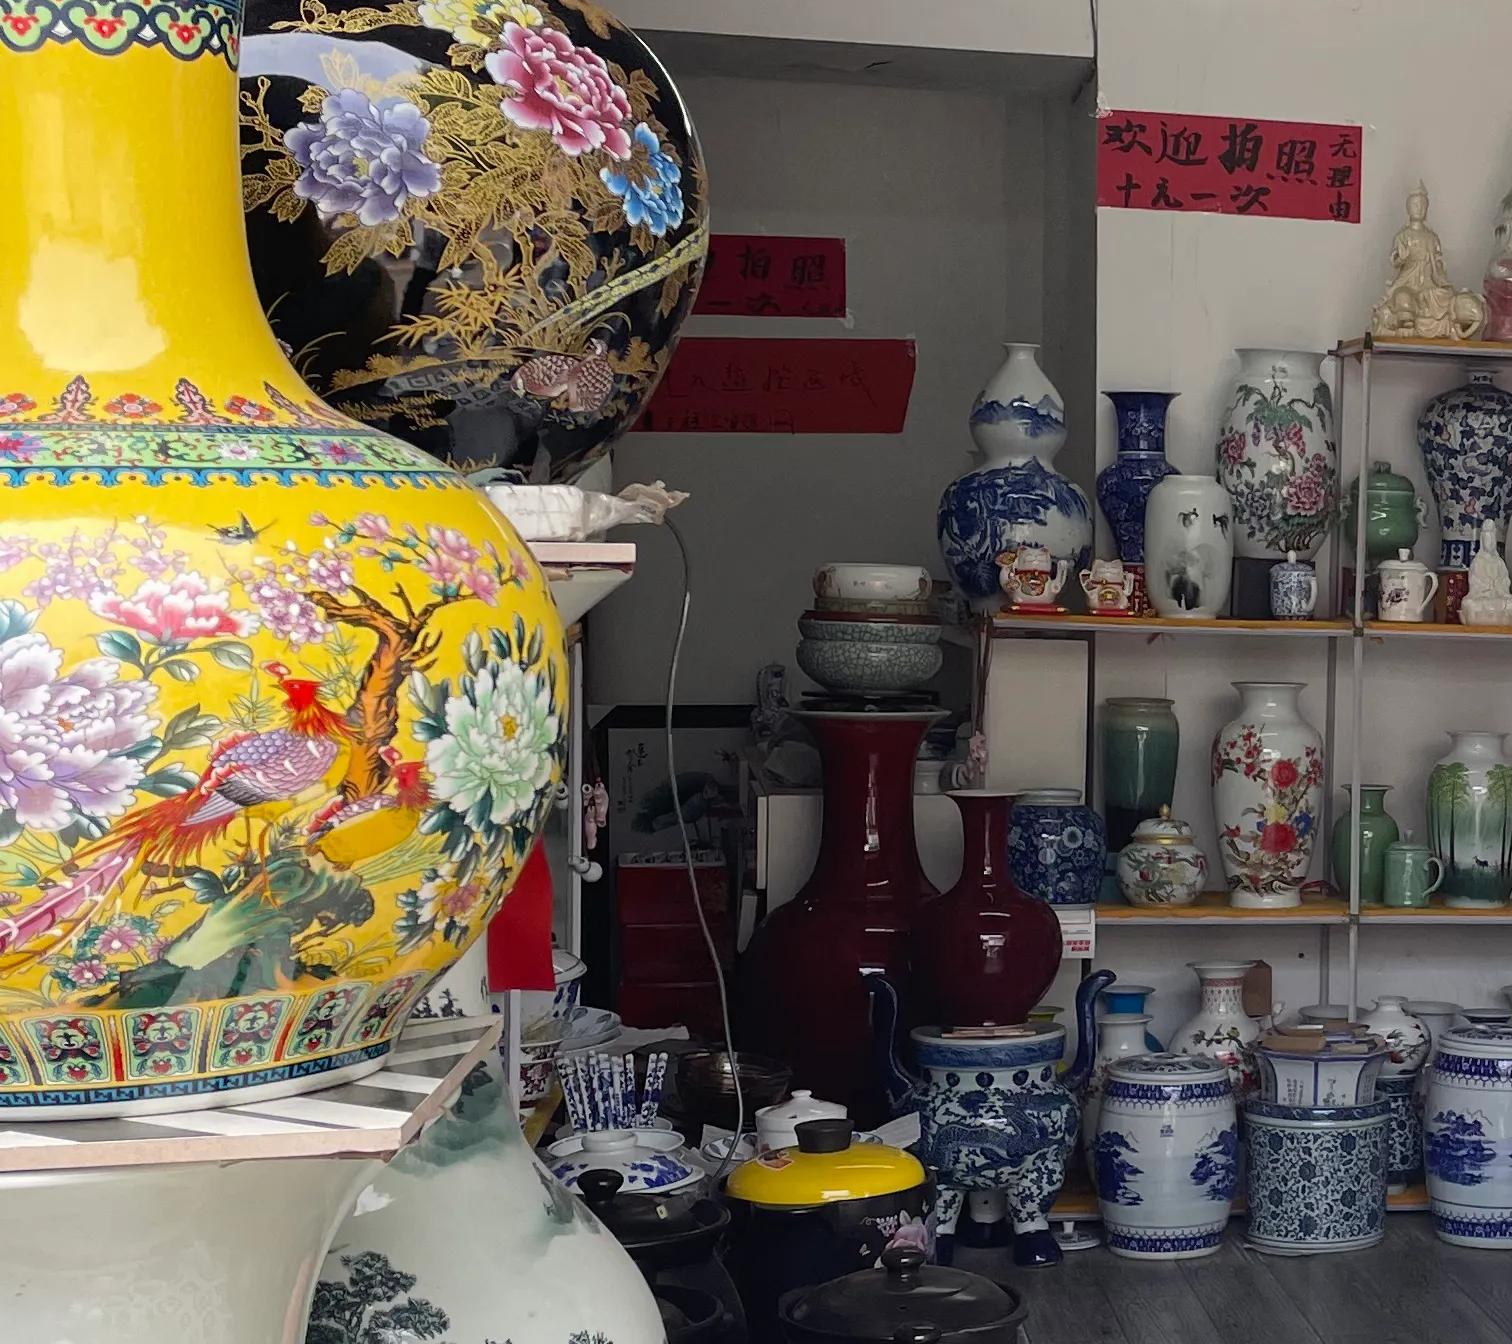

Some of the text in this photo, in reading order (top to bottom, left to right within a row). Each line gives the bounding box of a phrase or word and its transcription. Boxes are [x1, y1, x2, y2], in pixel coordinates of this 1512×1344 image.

[1102, 119, 1317, 185] 欢迎拍照
[1326, 133, 1357, 221] 无理由
